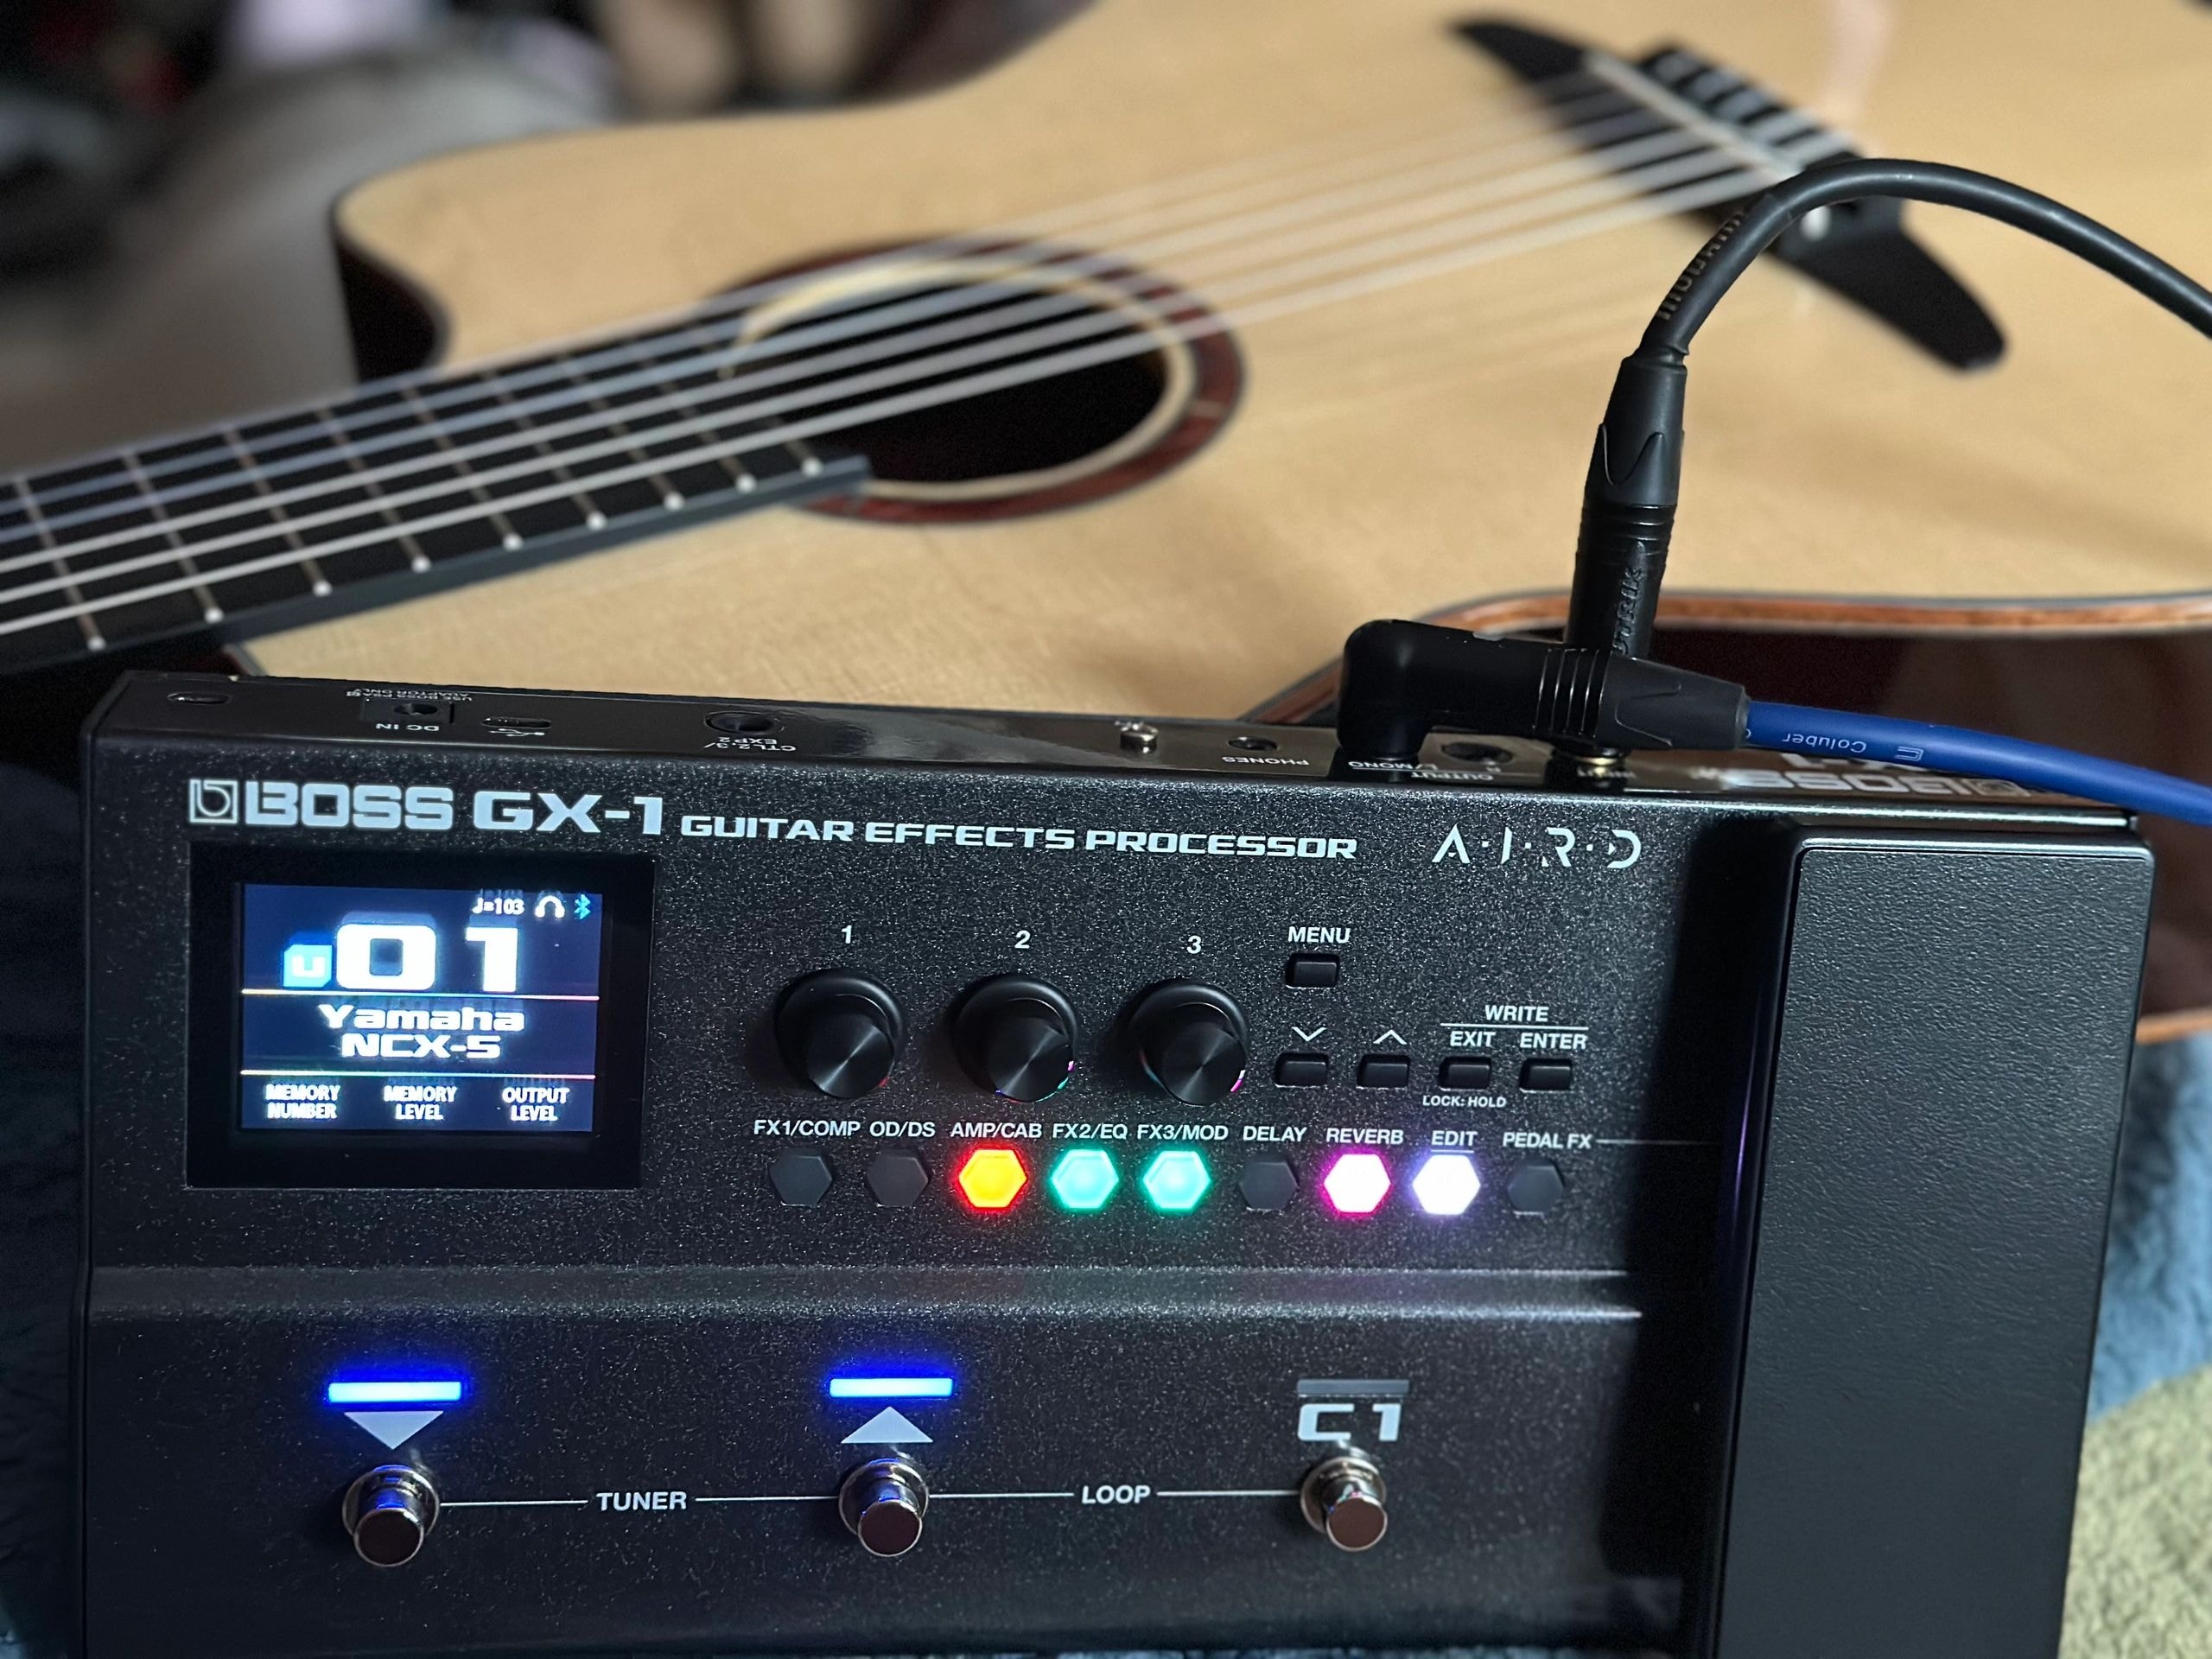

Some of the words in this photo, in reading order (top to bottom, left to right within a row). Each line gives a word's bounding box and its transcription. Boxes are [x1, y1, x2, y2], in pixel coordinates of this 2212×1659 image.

[375, 722, 400, 731] IN
[405, 723, 439, 732] DC
[1783, 733, 1867, 754] Coluber
[1222, 756, 1309, 766] PHONES
[1348, 760, 1439, 771] L/MONO
[1410, 772, 1494, 781] OUTPUT
[245, 780, 454, 830] BOSS
[473, 790, 664, 836] GX-1
[680, 815, 855, 842] GUITAR
[864, 821, 1076, 849] EFFECTS
[1084, 829, 1357, 860] PROCESSOR
[841, 925, 853, 944] 1
[1014, 930, 1031, 950] 2
[1287, 925, 1351, 944] MENU
[1186, 935, 1202, 955] 3
[335, 923, 519, 993] 01
[318, 1003, 525, 1032] Yamaha
[1484, 1004, 1549, 1023] WRITE
[340, 1033, 502, 1058] NCX-5
[1450, 1030, 1495, 1048] EXIT
[1519, 1032, 1588, 1051] ENTER
[265, 1084, 341, 1102] MEMORY
[384, 1084, 457, 1103] MEMORY
[502, 1086, 570, 1104] OUTPUT
[1422, 1094, 1466, 1108] LOCK:
[1467, 1095, 1508, 1109] HOLD
[266, 1102, 337, 1120] NUMBER
[395, 1103, 444, 1121] LEVEL
[510, 1103, 558, 1122] LEVEL
[753, 1119, 861, 1137] FX1/COMP
[869, 1121, 936, 1138] OD/DS
[950, 1122, 1043, 1140] AMP/CAB
[1052, 1122, 1128, 1141] FX2/EQ
[1136, 1123, 1229, 1141] FX3/MOD
[1243, 1125, 1307, 1143] DELAY
[1325, 1127, 1404, 1146] REVERB
[1431, 1129, 1478, 1147] EDIT
[1502, 1131, 1563, 1150] PEDAL
[1567, 1133, 1593, 1150] FX
[1297, 1402, 1402, 1441] C1
[596, 1490, 688, 1512] TUNER
[1082, 1484, 1151, 1505] LOOP
